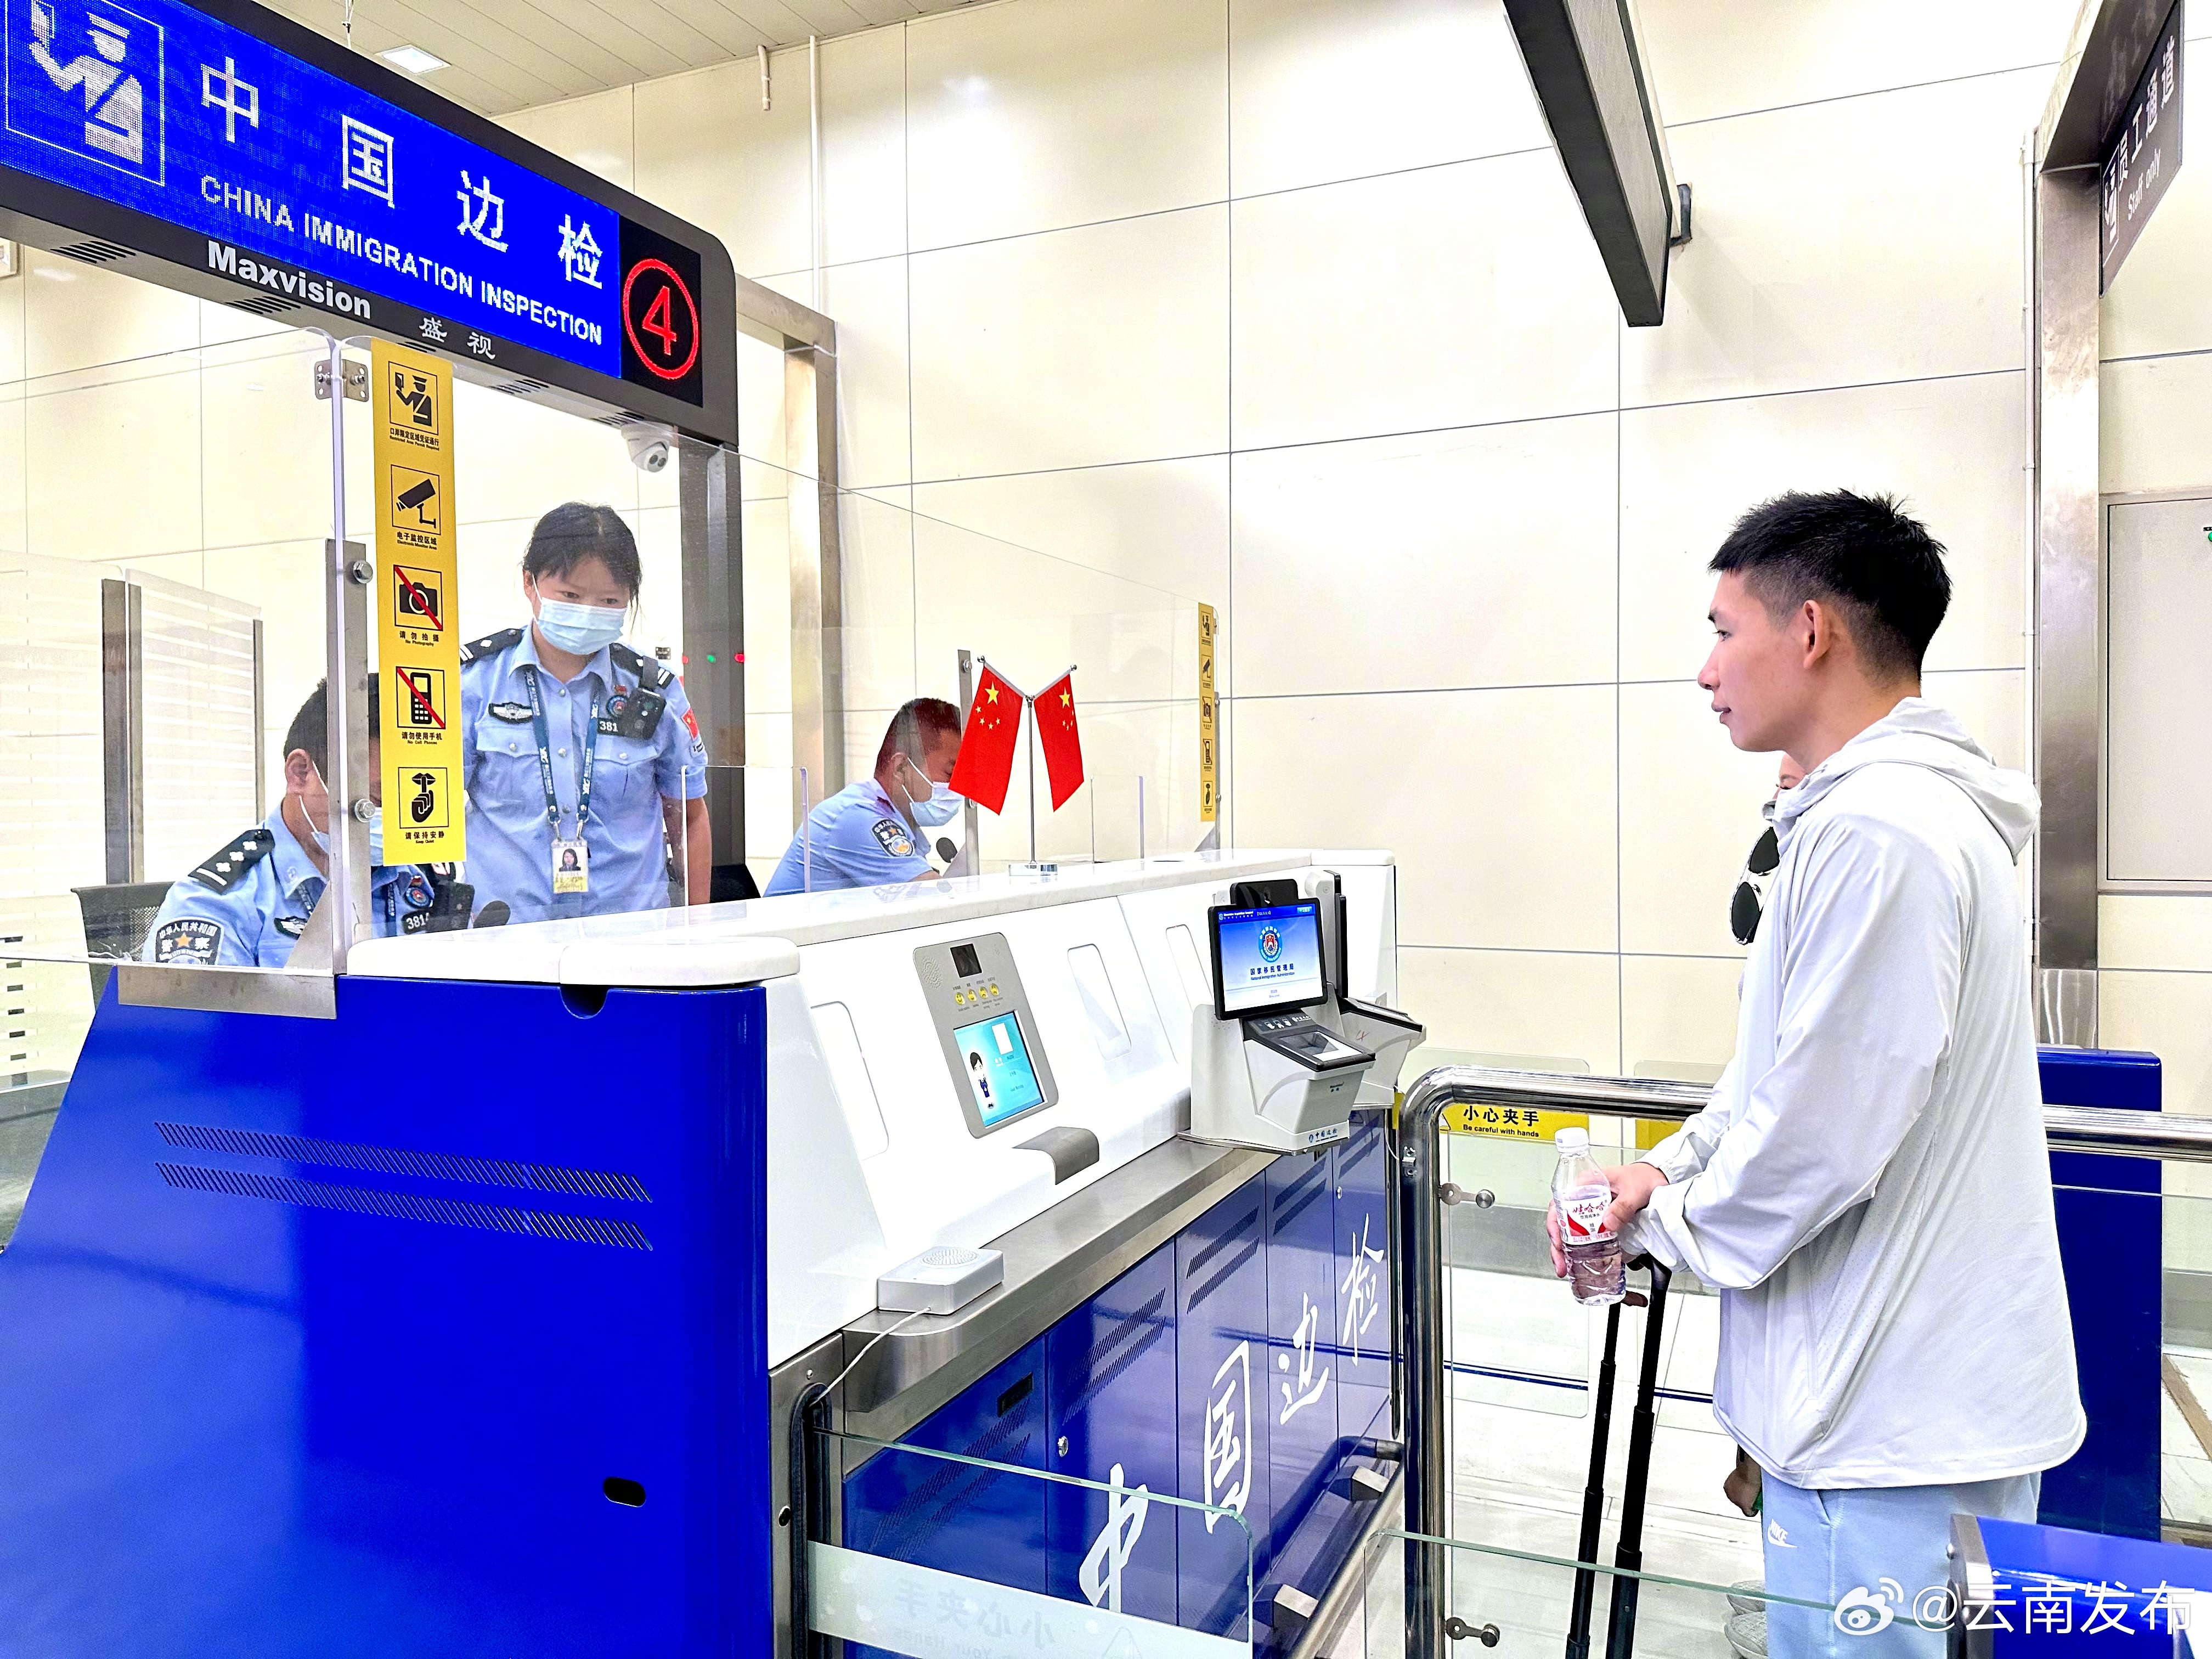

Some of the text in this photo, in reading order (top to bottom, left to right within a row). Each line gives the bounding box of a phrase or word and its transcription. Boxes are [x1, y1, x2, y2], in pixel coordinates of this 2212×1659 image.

[201, 56, 603, 289] 中国边检
[2128, 147, 2161, 221] Staff only
[201, 174, 602, 346] CHINA IMMIGRATION INSPECTION
[208, 239, 371, 320] Maxvision
[642, 285, 677, 356] 4
[419, 317, 496, 360] 盛视
[397, 531, 437, 545] 电子监控区域
[399, 630, 439, 642] 请勿拍摄
[402, 731, 442, 741] 请勿使用手机
[405, 830, 444, 840] 请保持安静
[1463, 1105, 1539, 1127] 小心夹手
[1517, 1129, 1539, 1137] hands
[1572, 1201, 1605, 1215] 娃哈哈
[1079, 1213, 1385, 1613] 中国边检
[1770, 1519, 1788, 1542] NIKE
